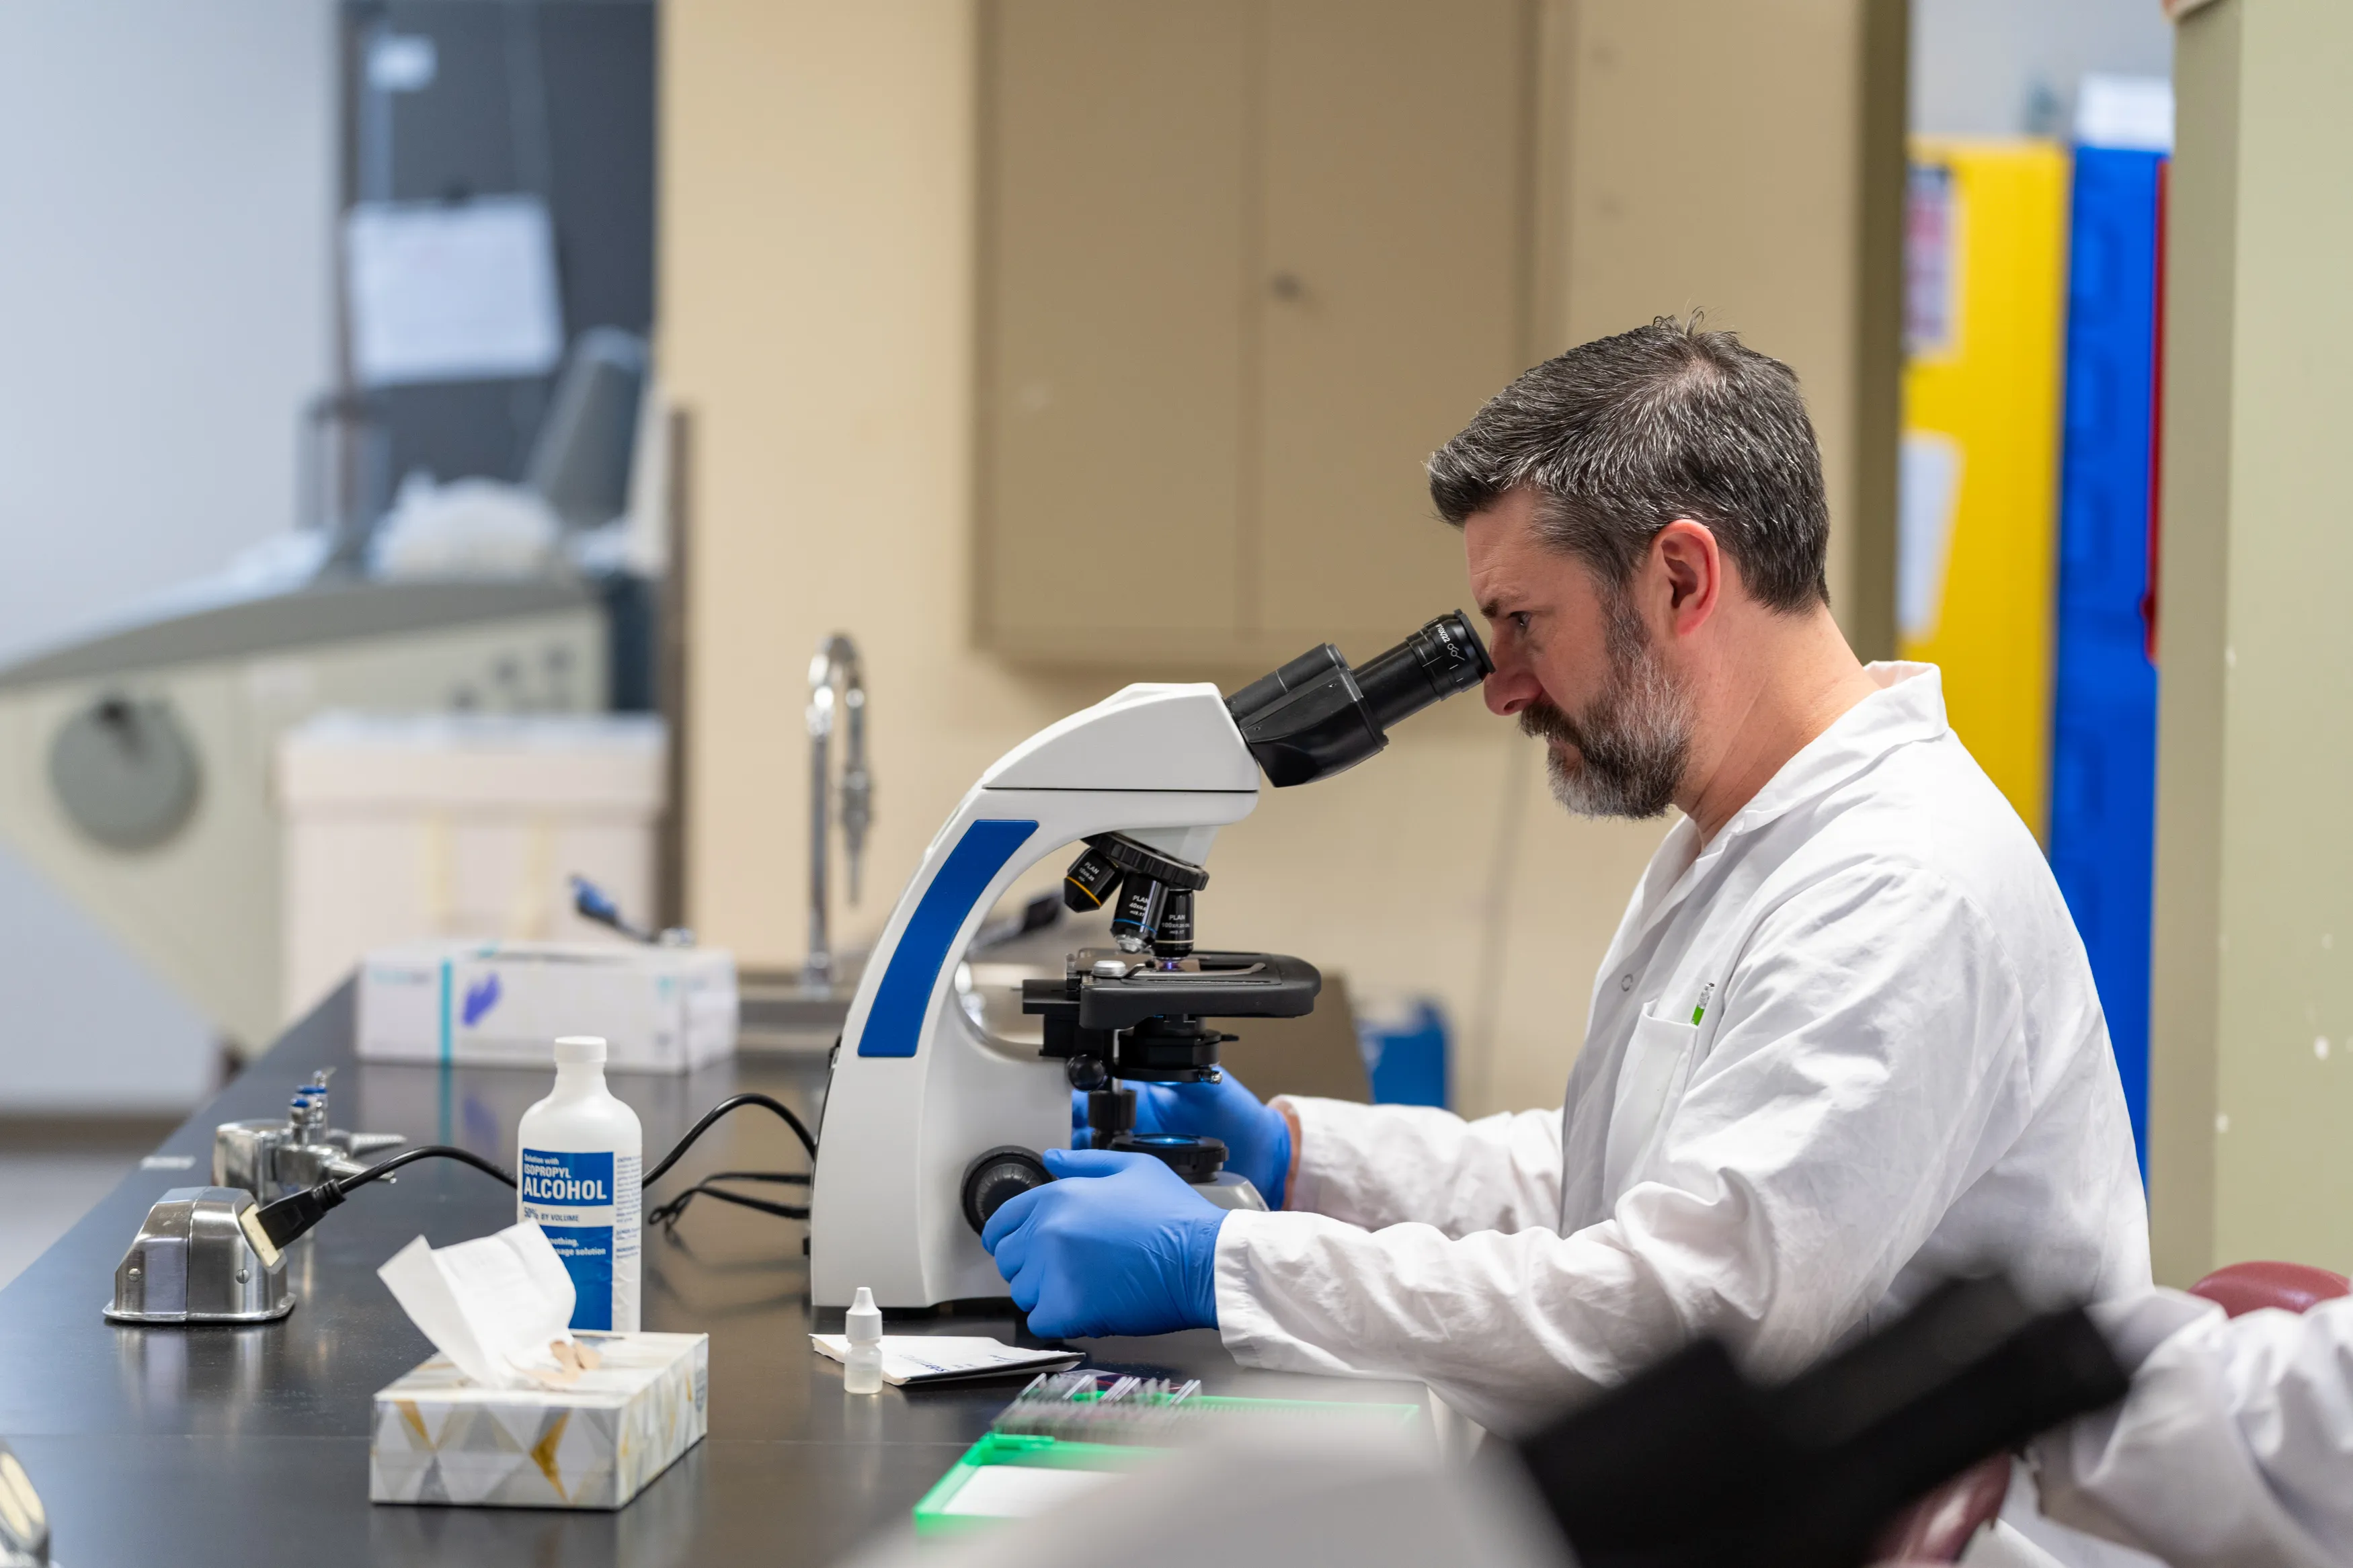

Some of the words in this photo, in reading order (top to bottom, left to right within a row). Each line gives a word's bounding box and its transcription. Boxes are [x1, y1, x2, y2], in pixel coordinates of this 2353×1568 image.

[1084, 861, 1100, 874] PLAN
[524, 1153, 544, 1163] Solution
[545, 1157, 559, 1165] with
[524, 1163, 571, 1179] ISOPROPYL
[524, 1176, 608, 1200] ALCOHOL
[541, 1212, 549, 1221] BY
[551, 1214, 580, 1222] VOLUME
[575, 1246, 606, 1256] solution
